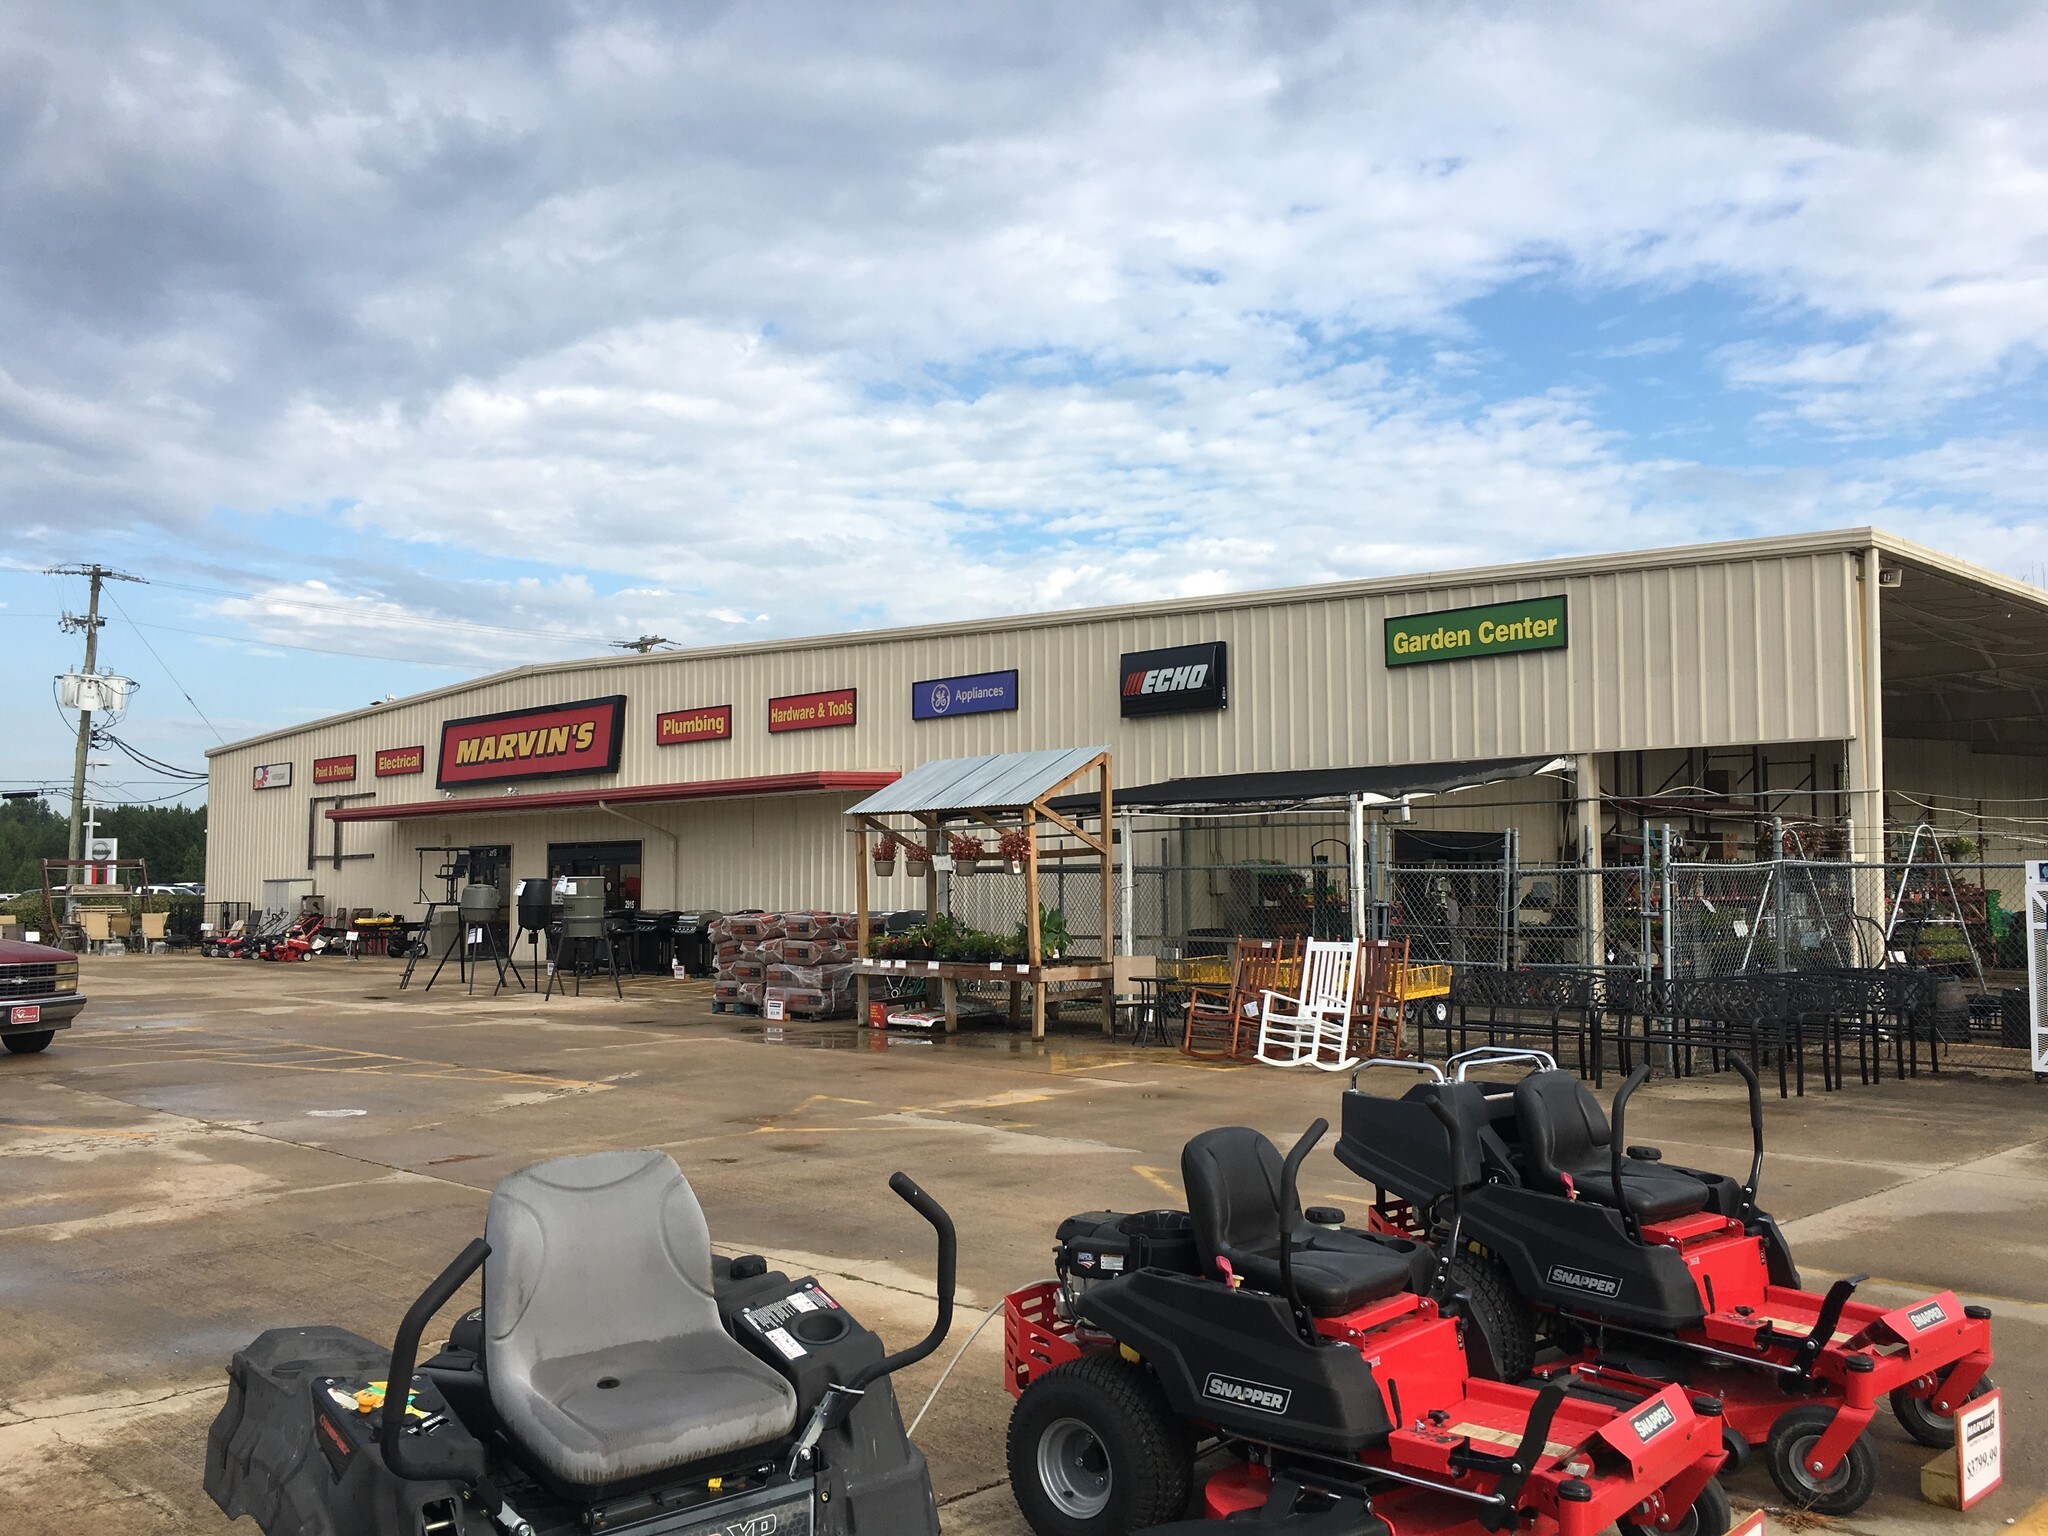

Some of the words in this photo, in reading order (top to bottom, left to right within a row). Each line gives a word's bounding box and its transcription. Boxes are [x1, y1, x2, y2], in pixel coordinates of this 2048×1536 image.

[1393, 627, 1471, 654] Garden
[1478, 617, 1558, 644] Center
[1140, 664, 1209, 695] ECHO
[955, 686, 1004, 704] Appliances
[771, 705, 815, 723] Hardware
[817, 703, 826, 718] &
[827, 700, 853, 716] Tools
[662, 714, 725, 735] Plumbing
[455, 721, 596, 766] MARVIN'S
[315, 766, 328, 778] Paint
[328, 765, 333, 776] &
[333, 764, 354, 777] Flooring
[378, 753, 420, 771] Electrical
[1551, 1268, 1616, 1294] SNAPPER
[1910, 1306, 1945, 1328] SNAPPER
[1209, 1378, 1284, 1409] SNAPPER
[1633, 1406, 1673, 1438] SNAPPER
